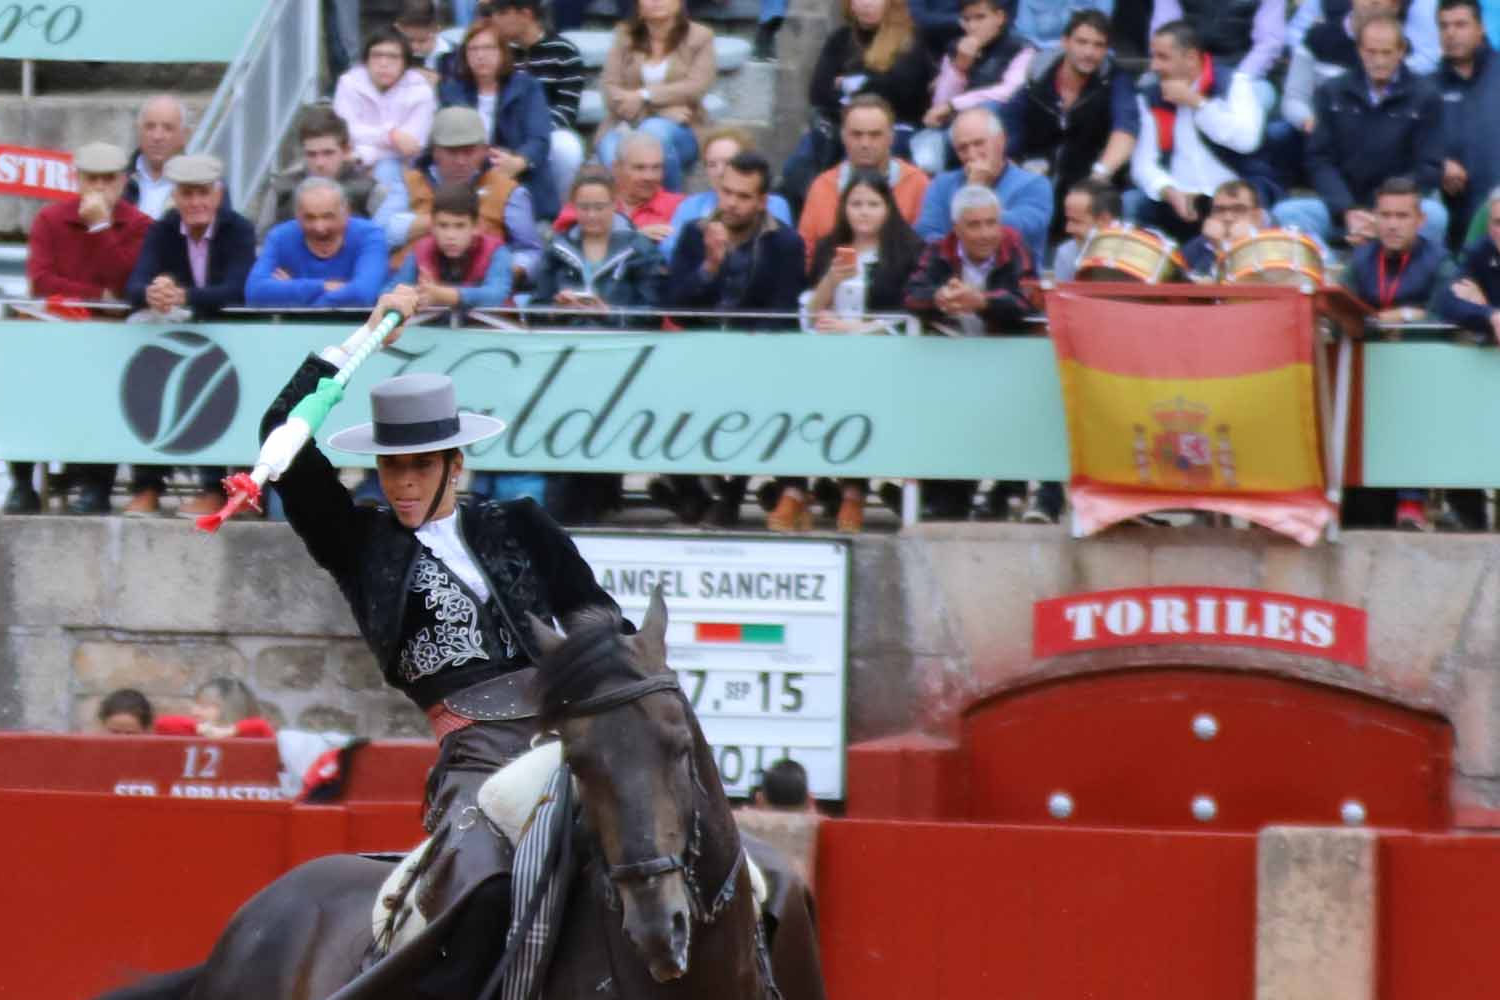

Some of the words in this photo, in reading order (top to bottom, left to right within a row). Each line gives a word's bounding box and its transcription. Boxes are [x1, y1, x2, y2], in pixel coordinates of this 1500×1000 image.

[382, 343, 874, 465] lduero
[601, 568, 688, 597] ANGEL
[699, 570, 827, 601] SANCHEZ
[1064, 596, 1336, 648] TORILES
[758, 671, 805, 712] 15
[182, 746, 221, 778] 12
